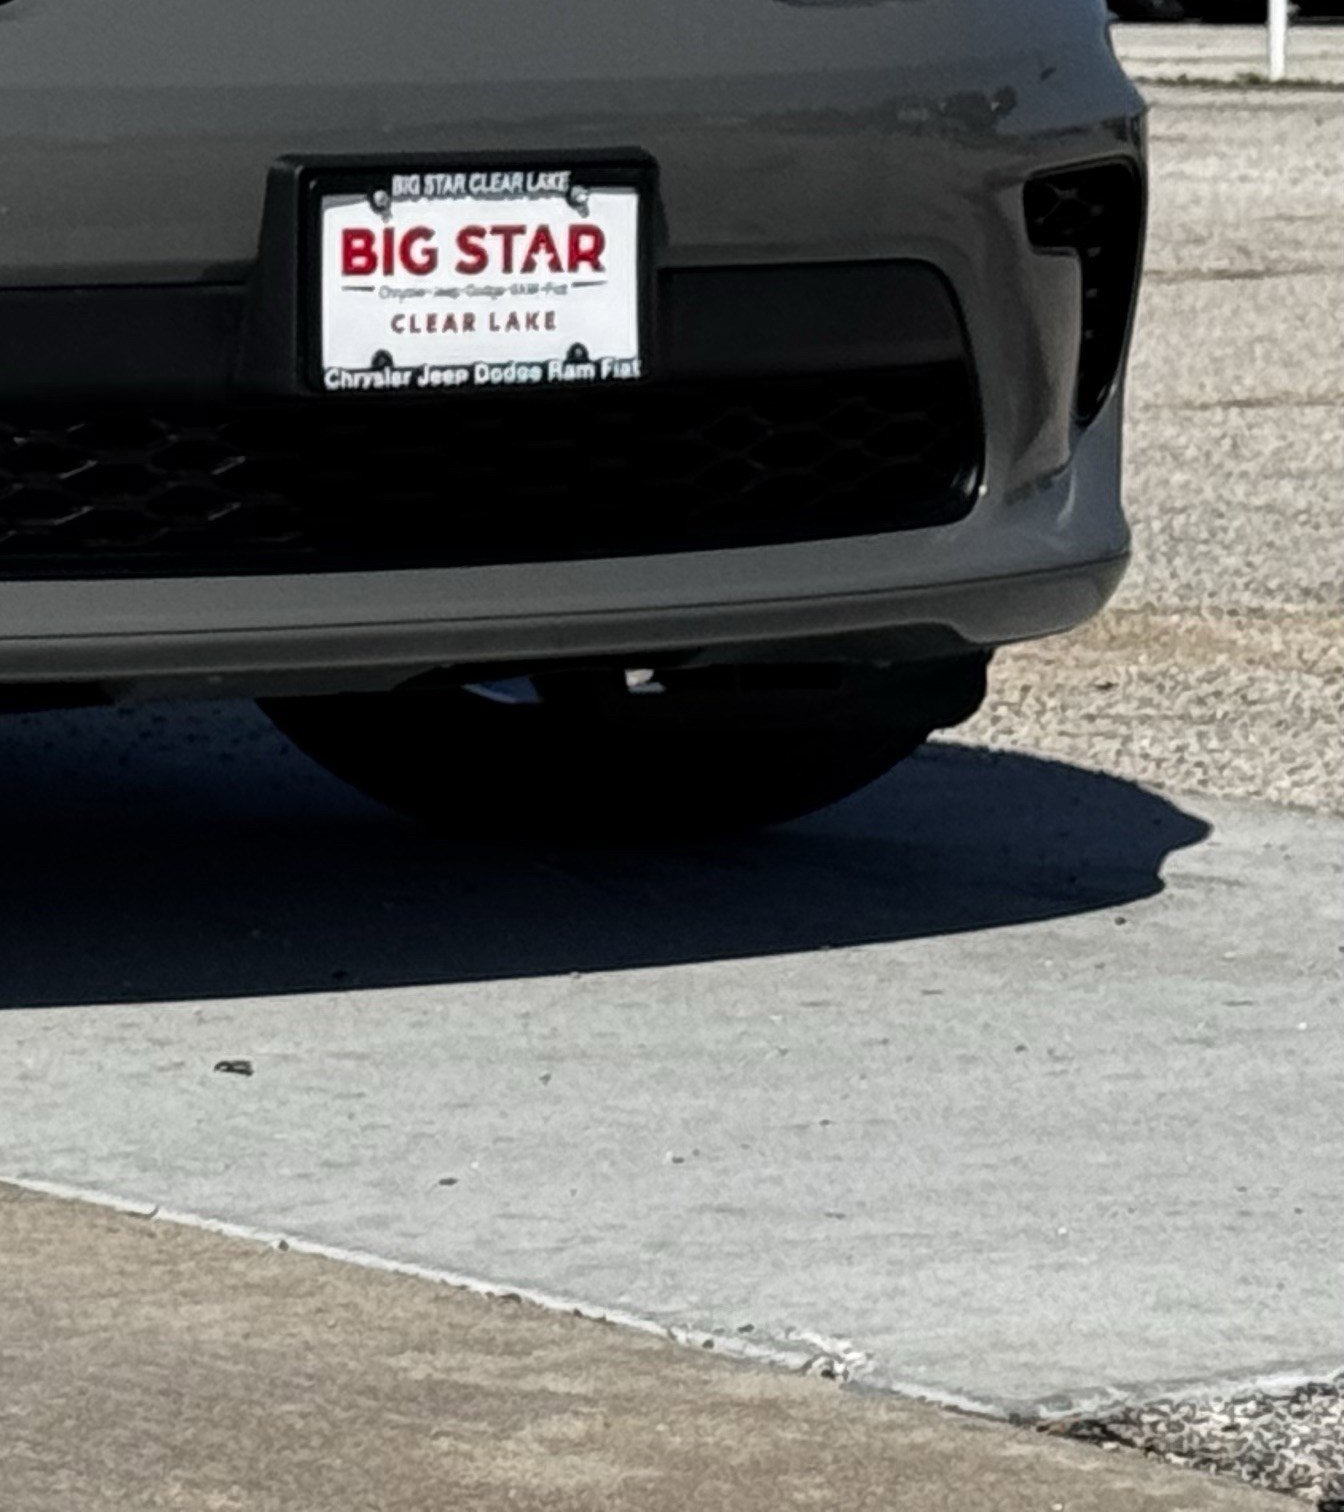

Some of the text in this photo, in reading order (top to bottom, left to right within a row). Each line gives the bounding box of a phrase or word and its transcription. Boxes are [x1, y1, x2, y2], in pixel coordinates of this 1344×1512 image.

[392, 170, 571, 196] BIG STAR CLEAR LAKE
[340, 223, 606, 277] BIG STAR
[390, 309, 557, 334] CLEAR LAKE
[323, 357, 642, 390] Chrysler Jeep Dodge Ram Fiat
